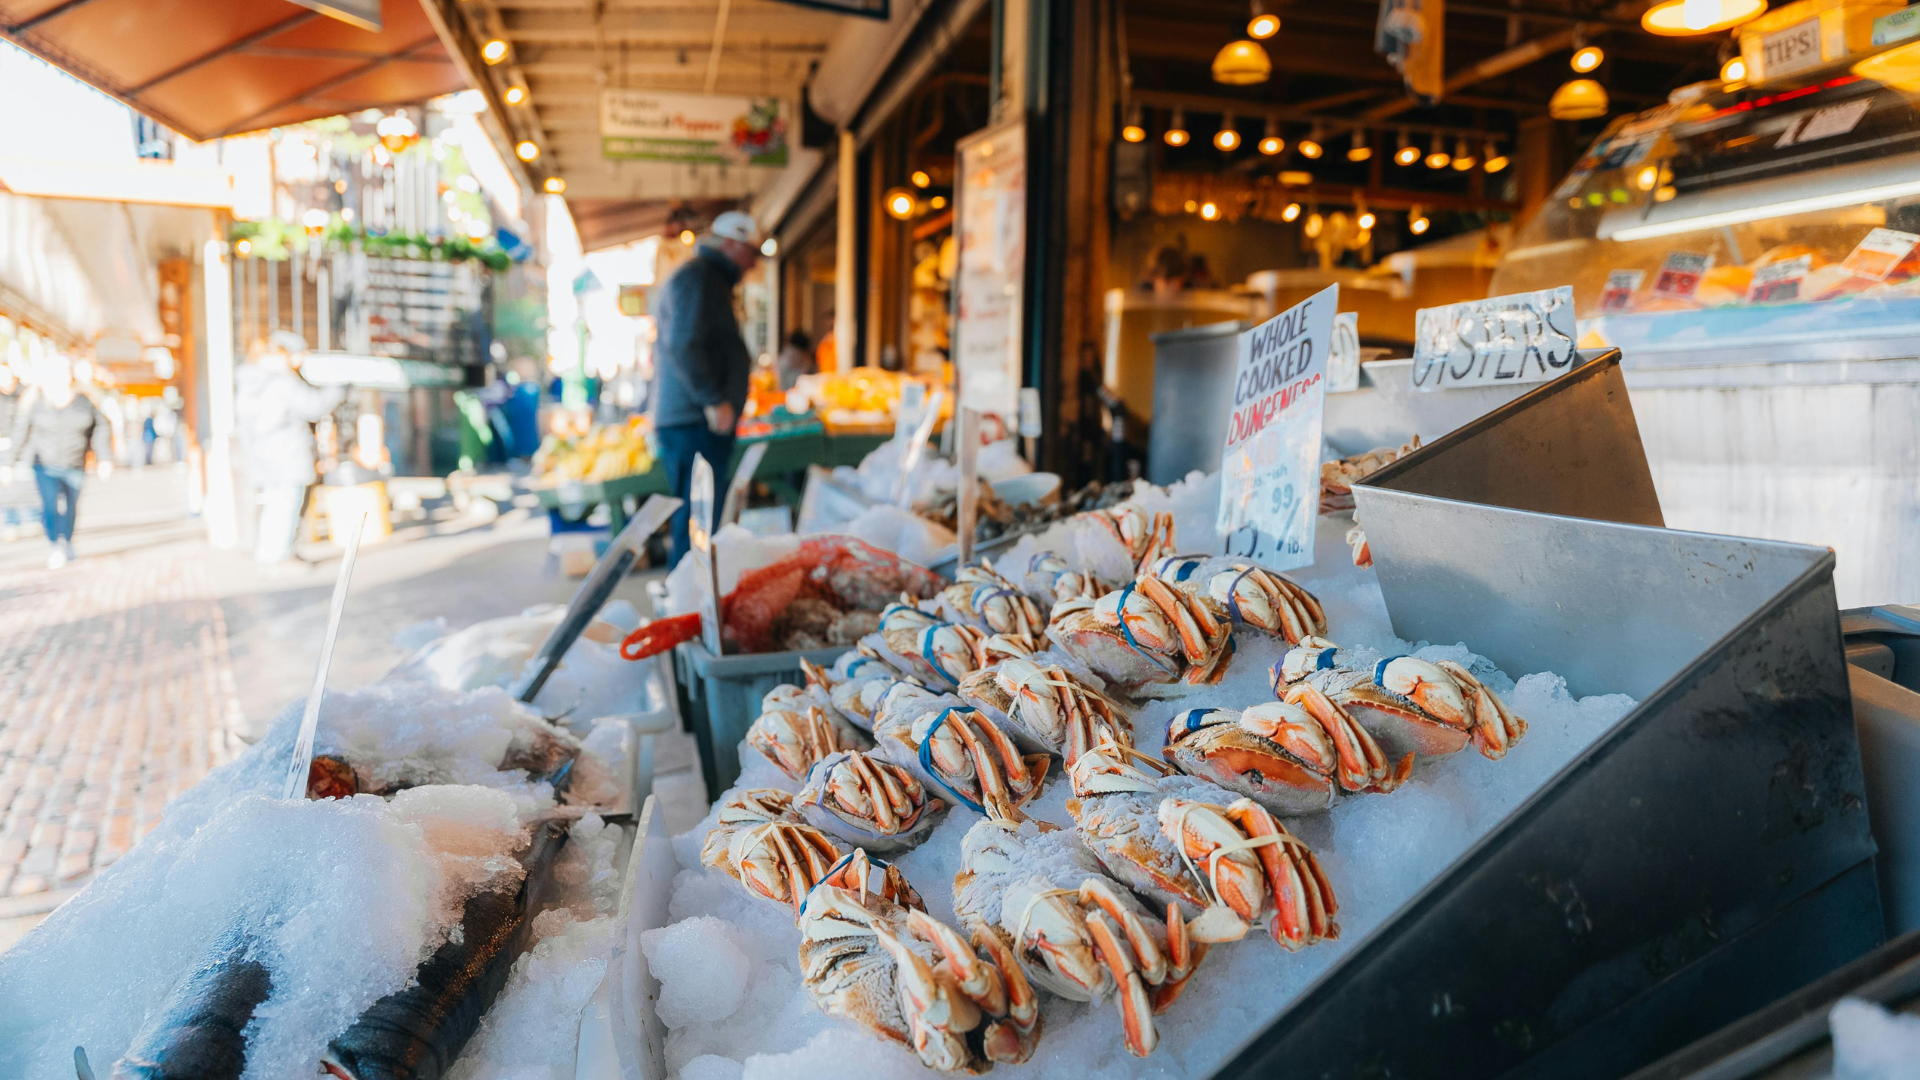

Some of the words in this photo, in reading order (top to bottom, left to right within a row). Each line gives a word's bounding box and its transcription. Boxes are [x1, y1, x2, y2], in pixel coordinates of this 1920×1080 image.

[1250, 300, 1313, 363] WHOLE
[1234, 337, 1313, 406] COOKED
[1227, 372, 1321, 446] DUNGENESS
